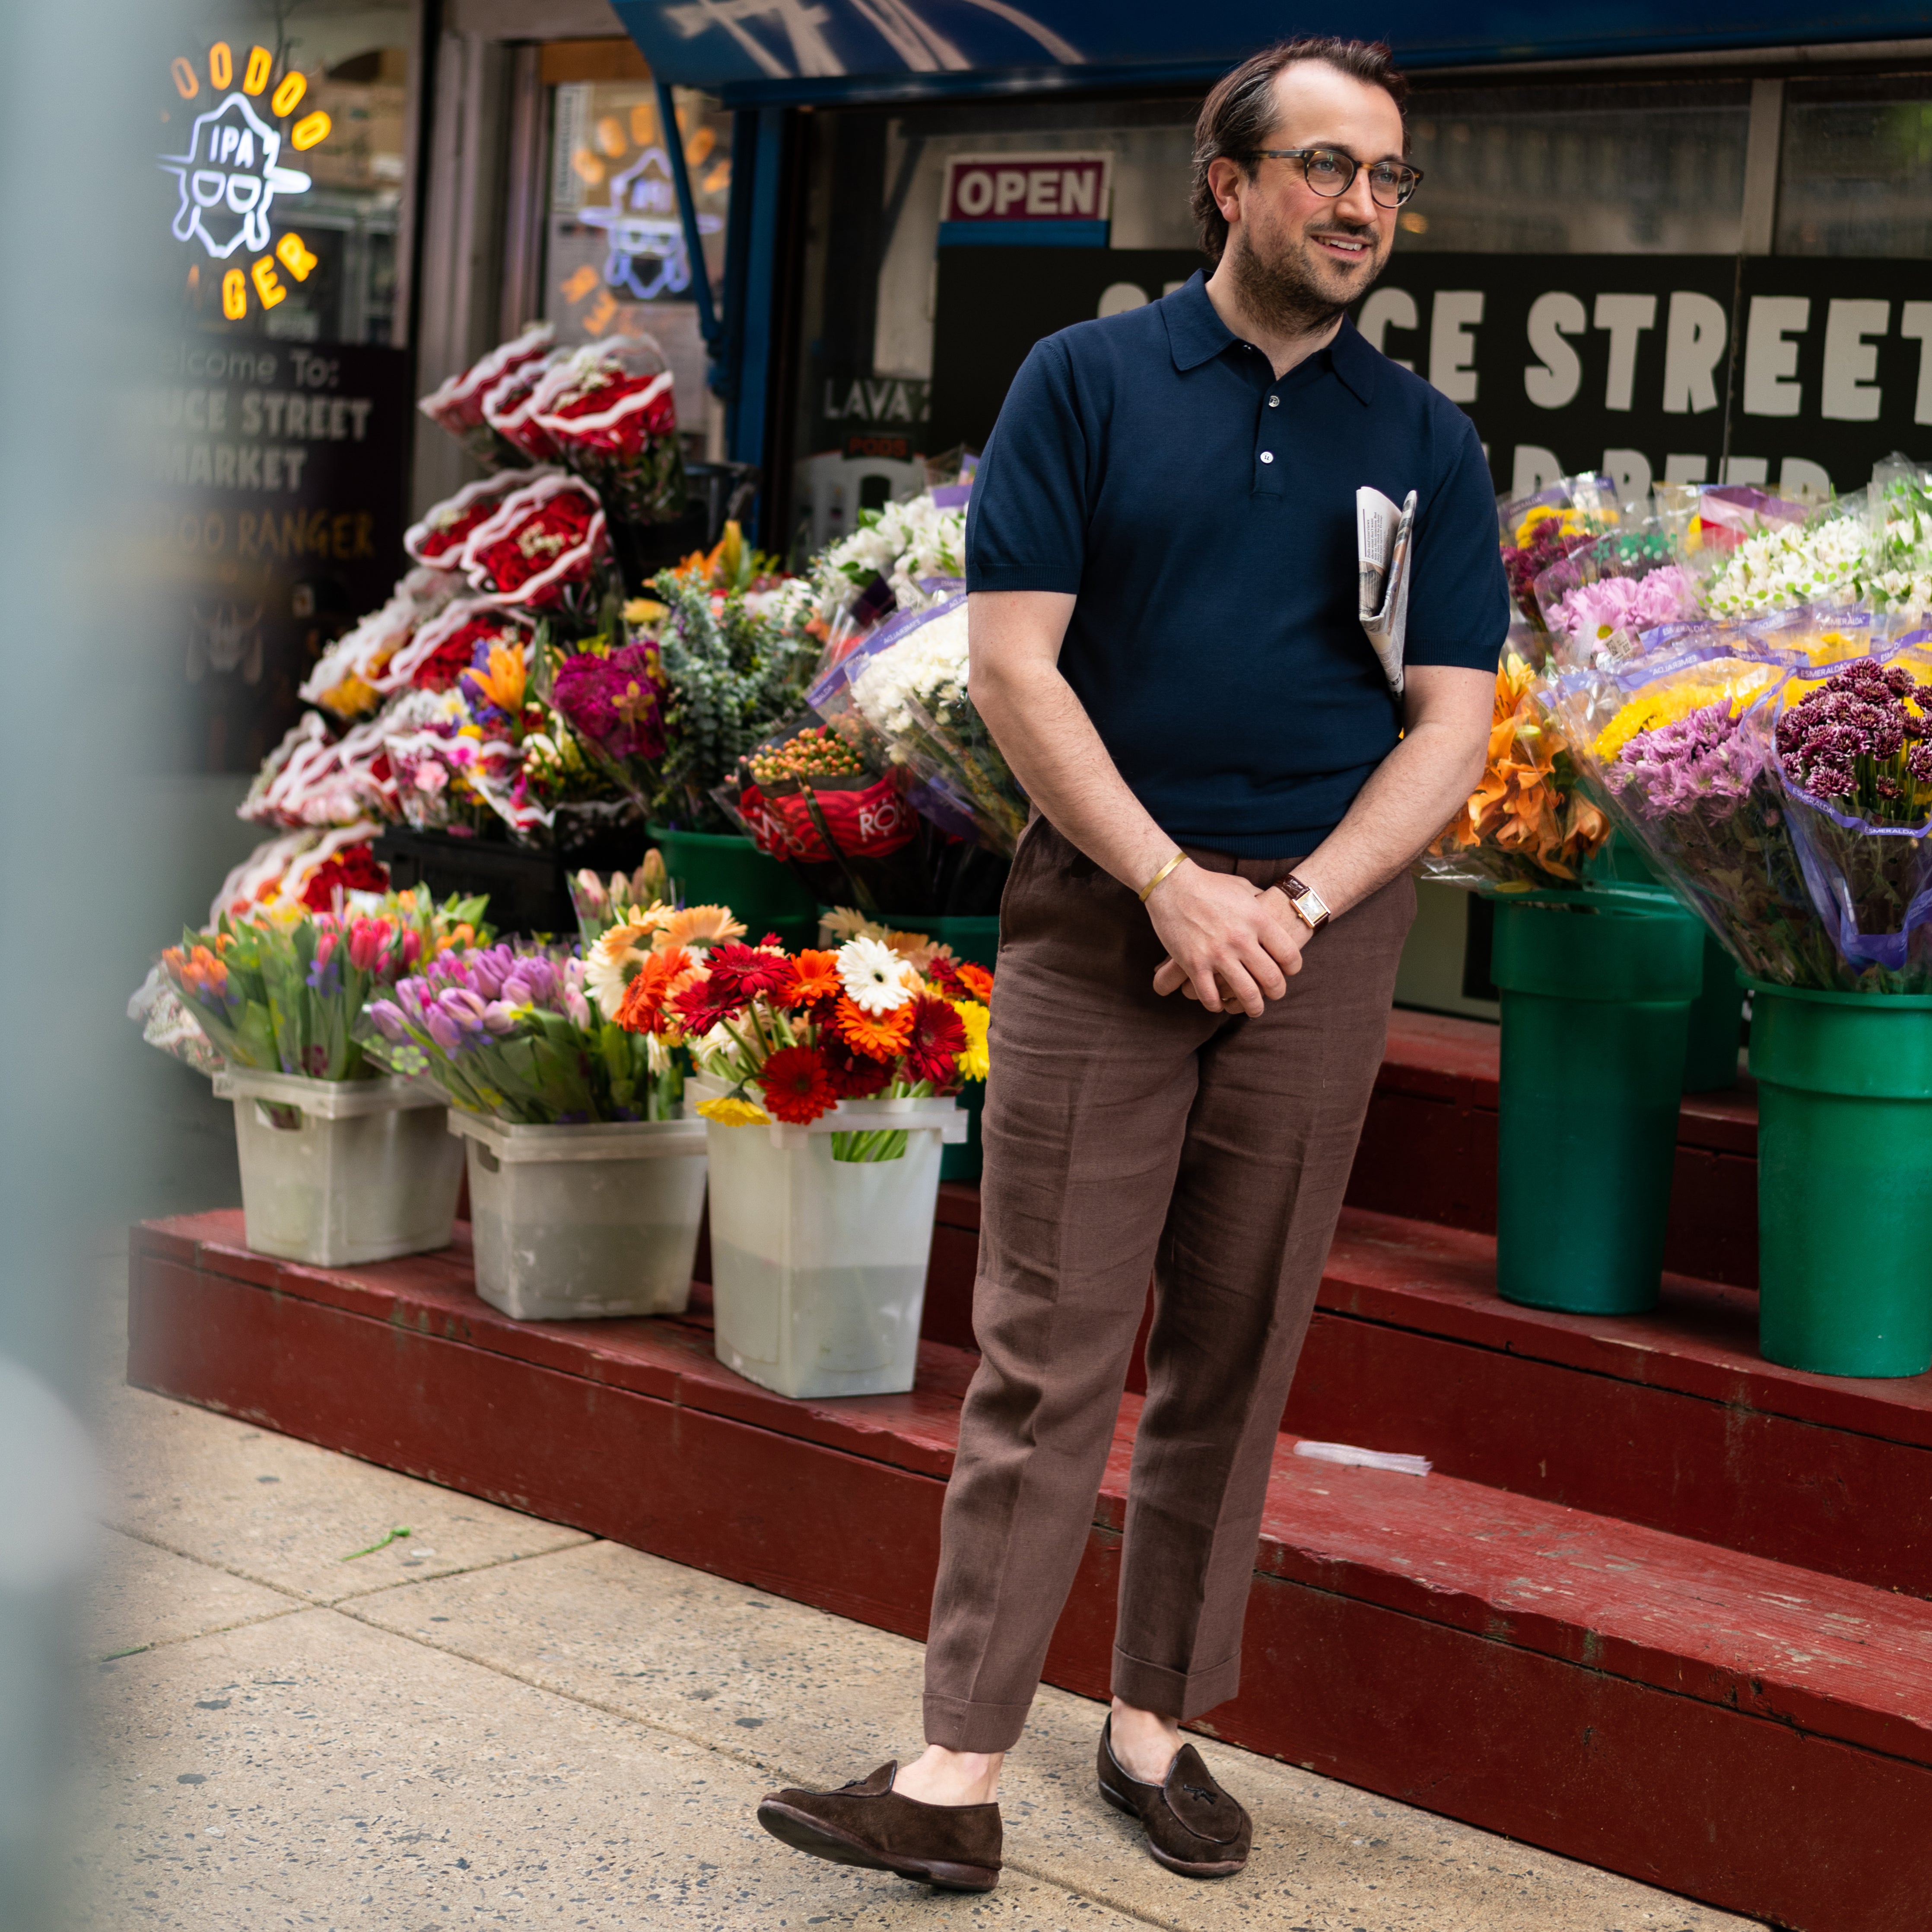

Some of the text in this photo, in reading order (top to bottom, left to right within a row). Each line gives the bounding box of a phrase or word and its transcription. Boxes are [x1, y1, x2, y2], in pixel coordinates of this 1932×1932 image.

[160, 41, 332, 152] OODOO
[209, 124, 254, 168] IPA
[957, 169, 1096, 216] OPEN
[289, 349, 340, 388] To:
[241, 390, 373, 442] STREET
[237, 506, 375, 560] RANGER
[1662, 625, 1704, 637] ESMERALDA
[1828, 616, 1863, 626] MERALDA
[1800, 662, 1846, 678] ESMERALDA
[1792, 788, 1833, 816] ESMERALDA
[1864, 826, 1915, 836] ESMERALDA
